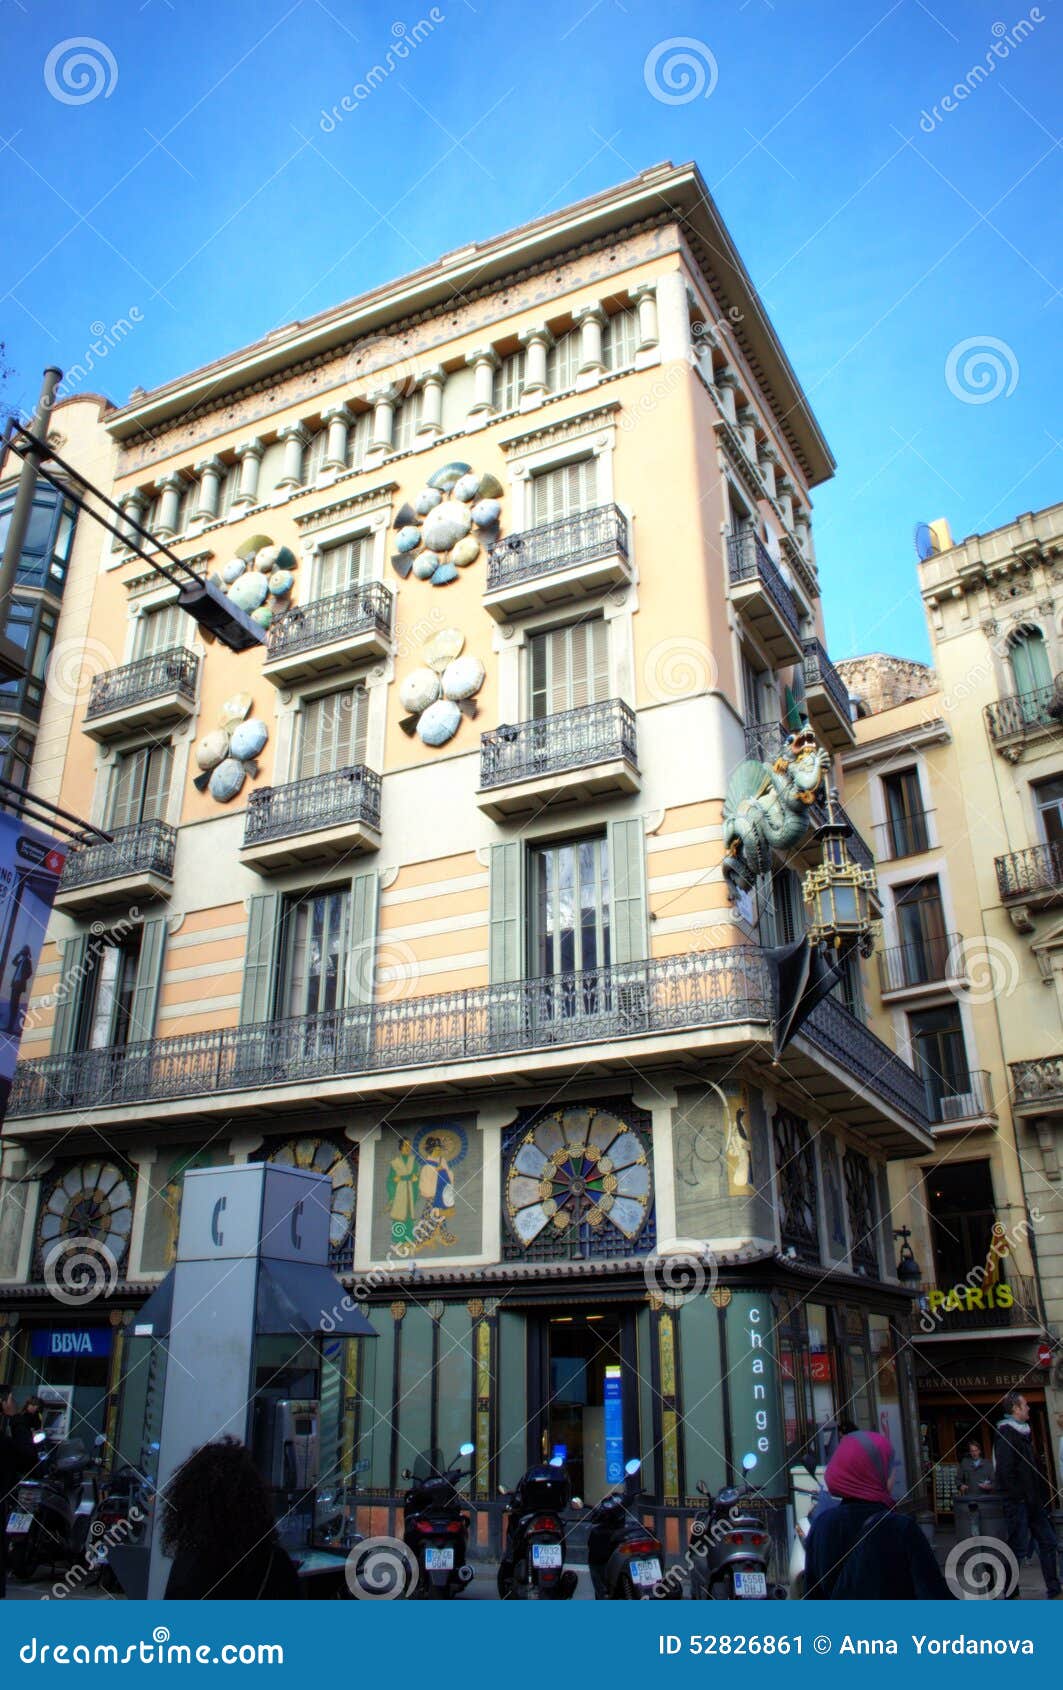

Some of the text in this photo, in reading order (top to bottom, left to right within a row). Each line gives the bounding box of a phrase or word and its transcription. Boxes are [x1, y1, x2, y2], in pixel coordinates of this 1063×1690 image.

[927, 1283, 1014, 1312] PARIS
[51, 1332, 93, 1353] BBVA
[749, 1308, 769, 1451] change
